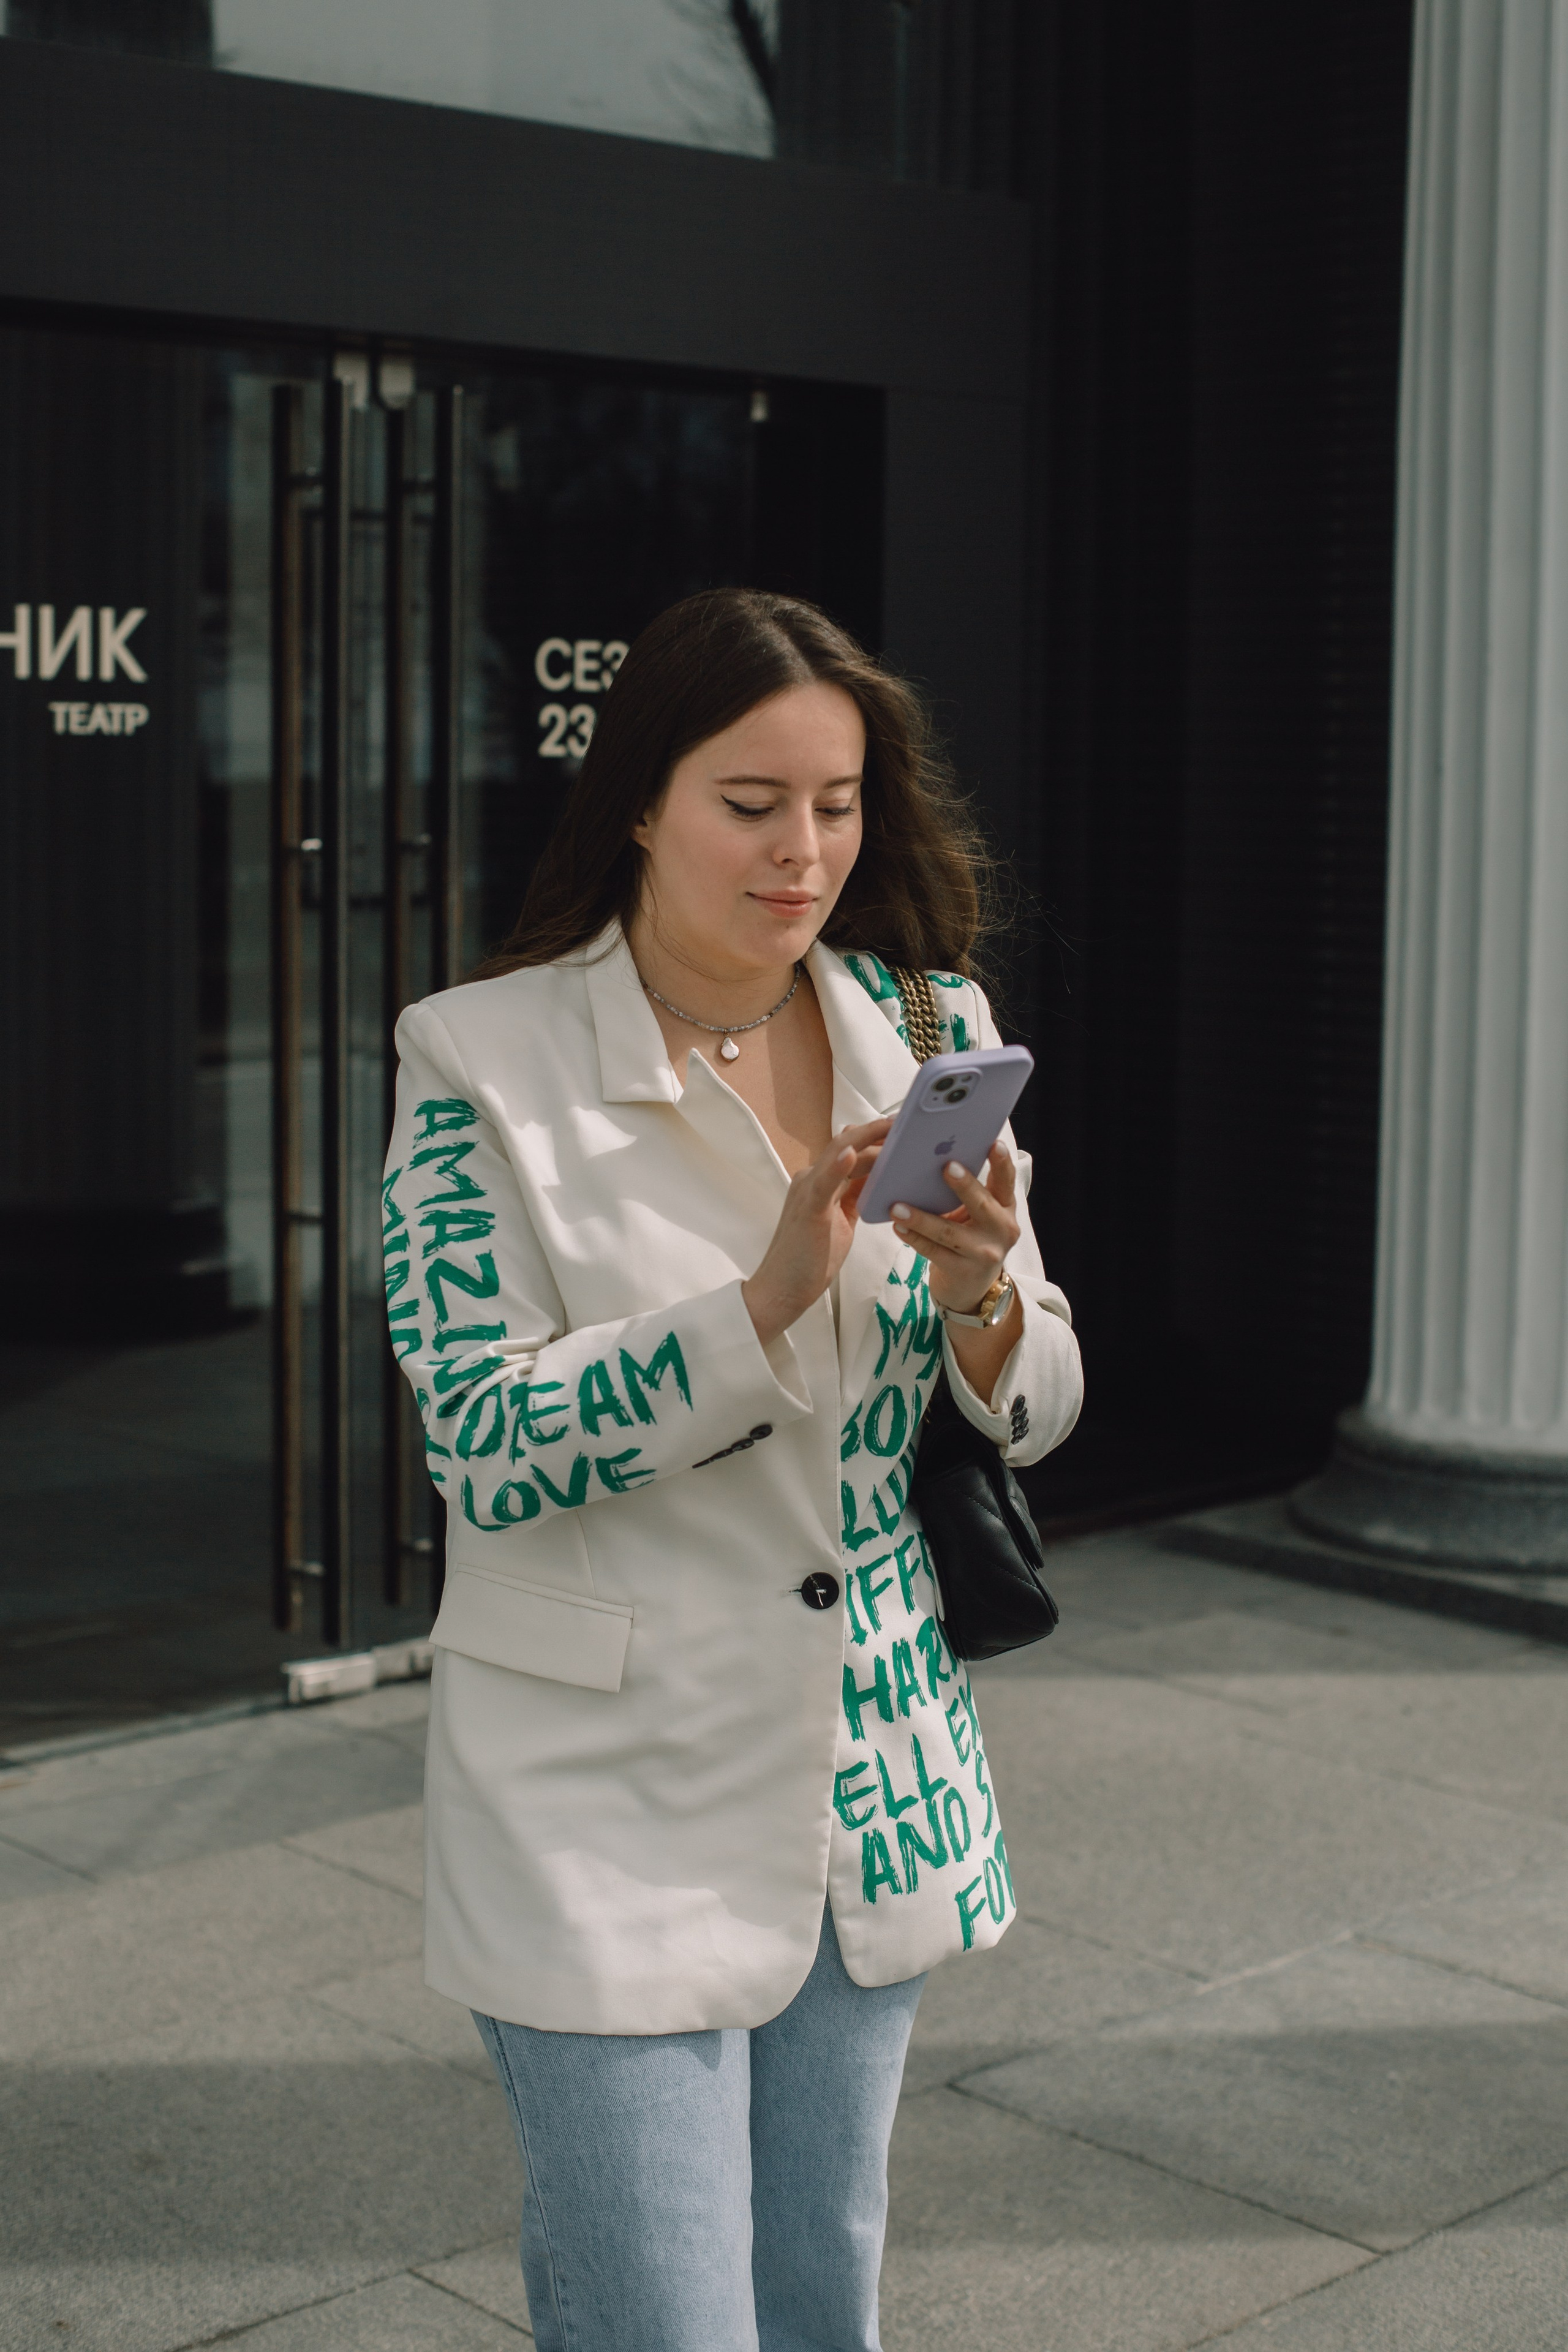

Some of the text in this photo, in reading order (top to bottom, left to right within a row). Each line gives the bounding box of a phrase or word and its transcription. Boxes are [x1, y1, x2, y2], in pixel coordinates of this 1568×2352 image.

[49, 702, 149, 735] ТЕАТР
[461, 1447, 657, 1532] LOVE
[861, 1787, 972, 1905] AND
